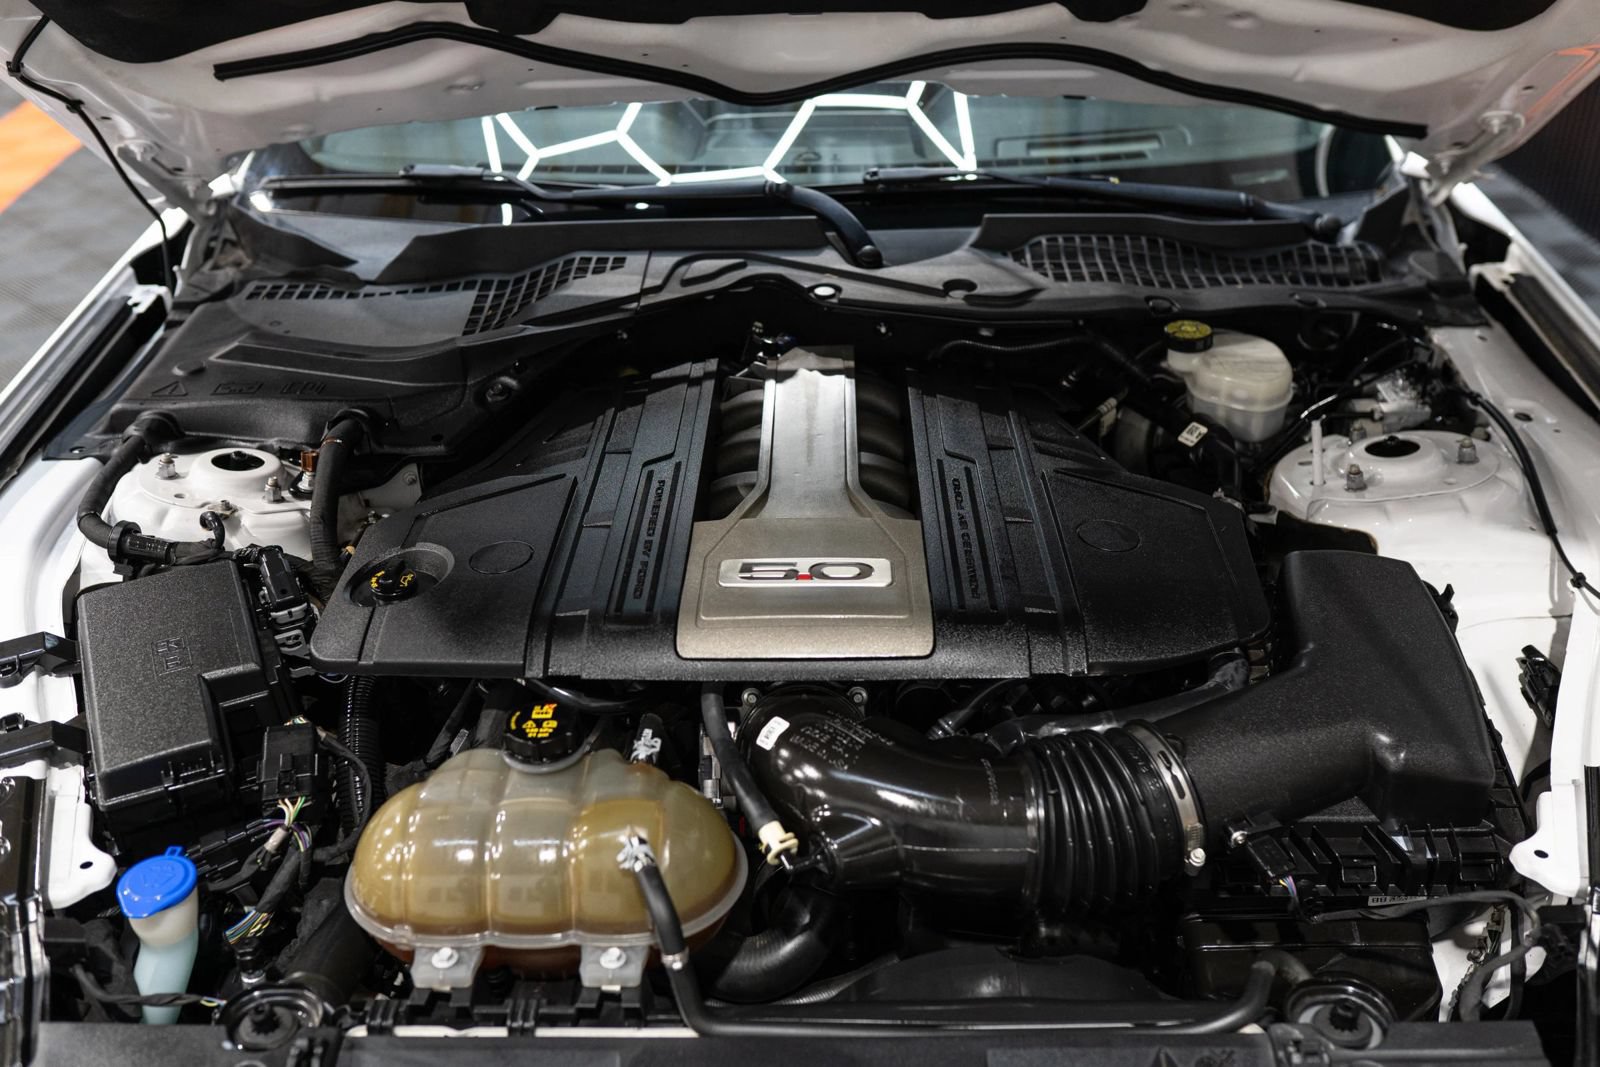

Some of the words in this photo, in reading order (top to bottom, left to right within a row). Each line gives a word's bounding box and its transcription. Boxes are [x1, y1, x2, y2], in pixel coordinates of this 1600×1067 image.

[647, 480, 665, 537] POWERED
[952, 478, 965, 510] FORD
[958, 512, 968, 530] BY
[642, 540, 653, 557] BY
[633, 561, 648, 599] FORD
[738, 562, 875, 580] 5.0
[961, 532, 980, 599] POWERED
